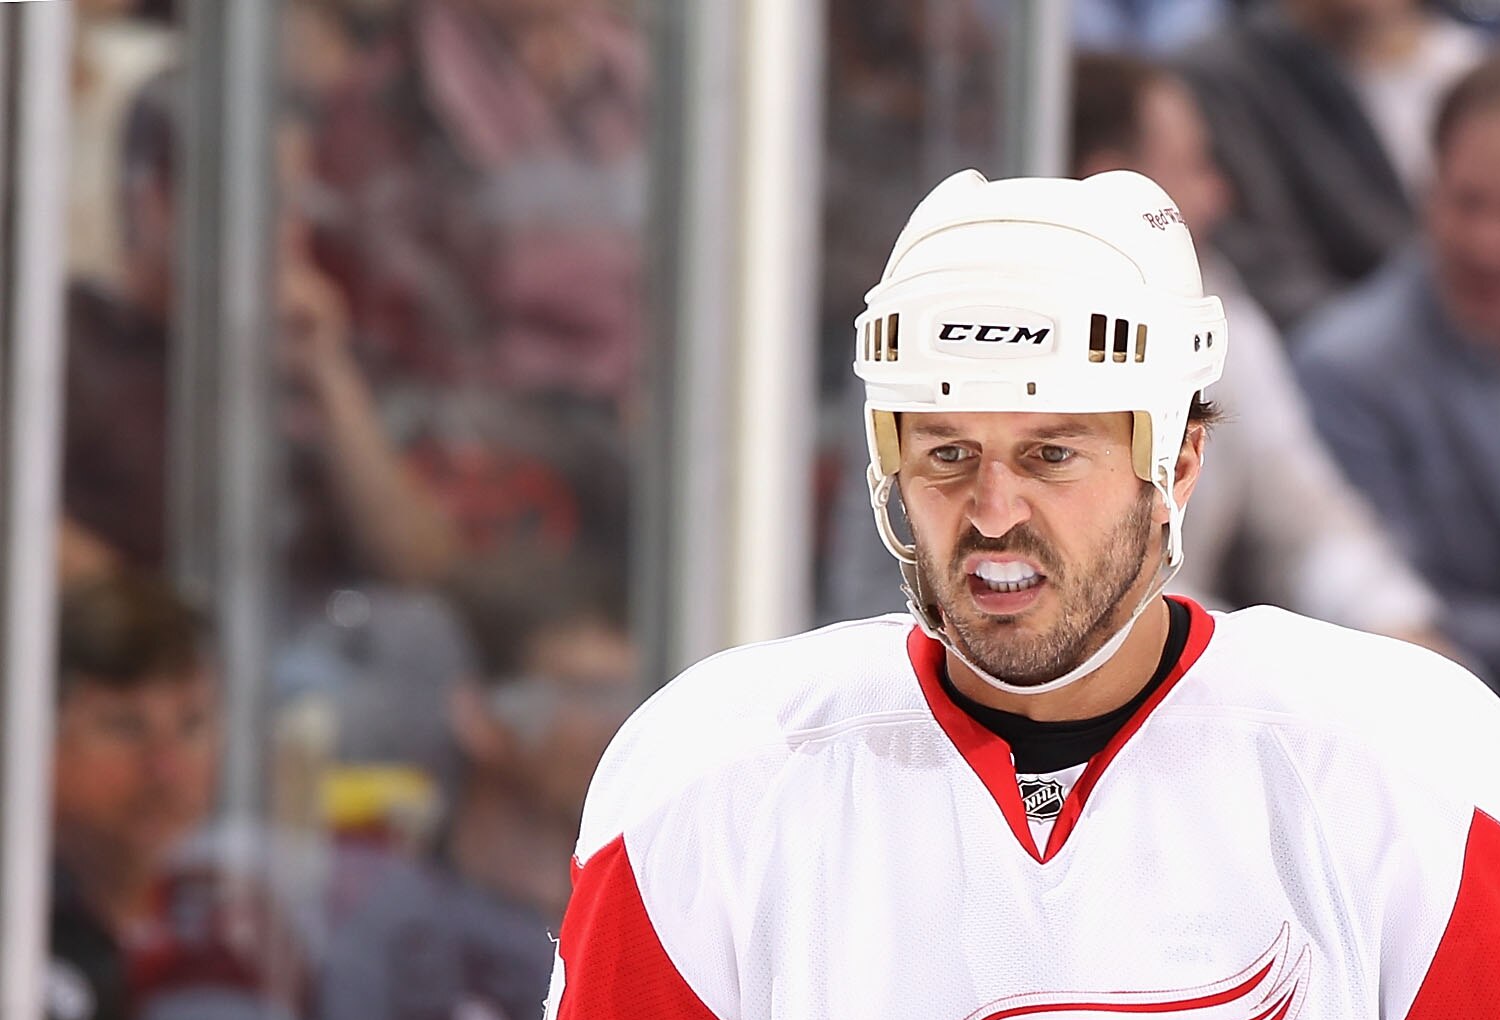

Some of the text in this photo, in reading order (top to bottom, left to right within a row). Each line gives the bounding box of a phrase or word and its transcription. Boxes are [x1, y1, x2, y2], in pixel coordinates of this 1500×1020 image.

[1142, 208, 1169, 231] Red
[938, 323, 1050, 344] CCM
[1024, 787, 1057, 812] NHL
